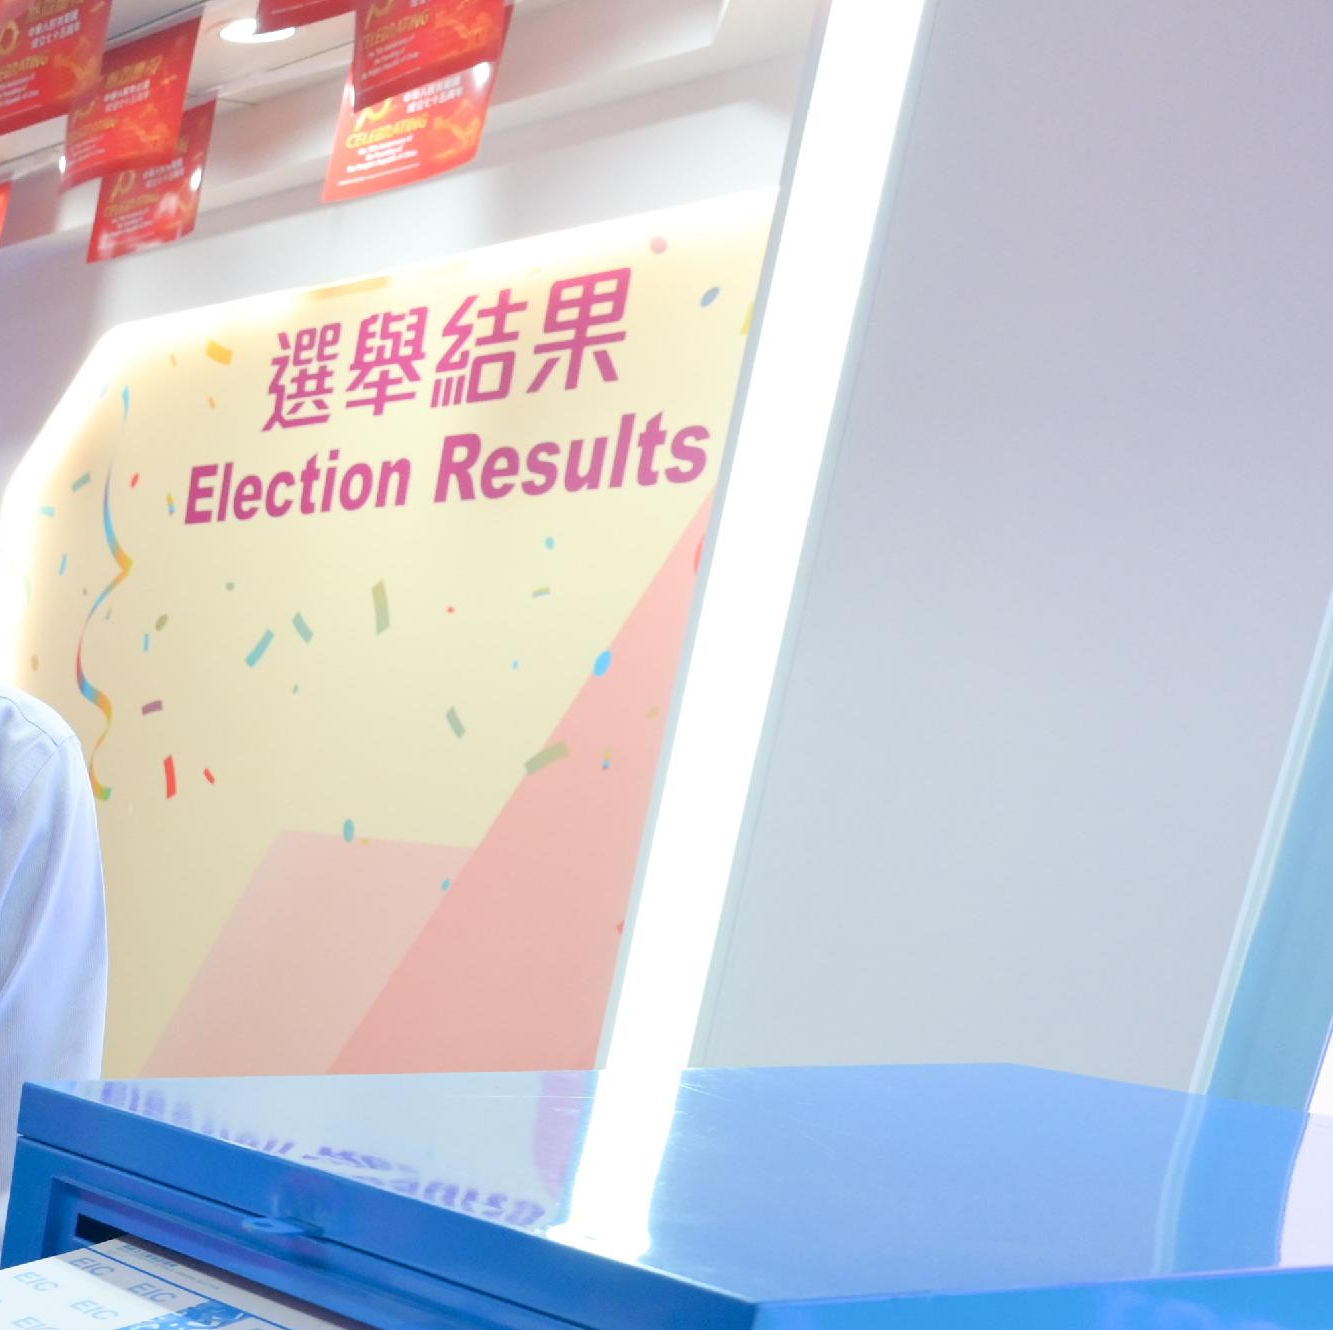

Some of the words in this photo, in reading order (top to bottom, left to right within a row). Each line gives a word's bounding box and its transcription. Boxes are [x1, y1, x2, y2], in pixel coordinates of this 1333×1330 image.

[261, 267, 633, 433] 選舉結果
[183, 448, 412, 526] Election
[434, 409, 710, 505] Results
[69, 1256, 116, 1277] EIC
[12, 1270, 59, 1293] EIC
[128, 1281, 178, 1304] EIC
[69, 1298, 119, 1321] EIC
